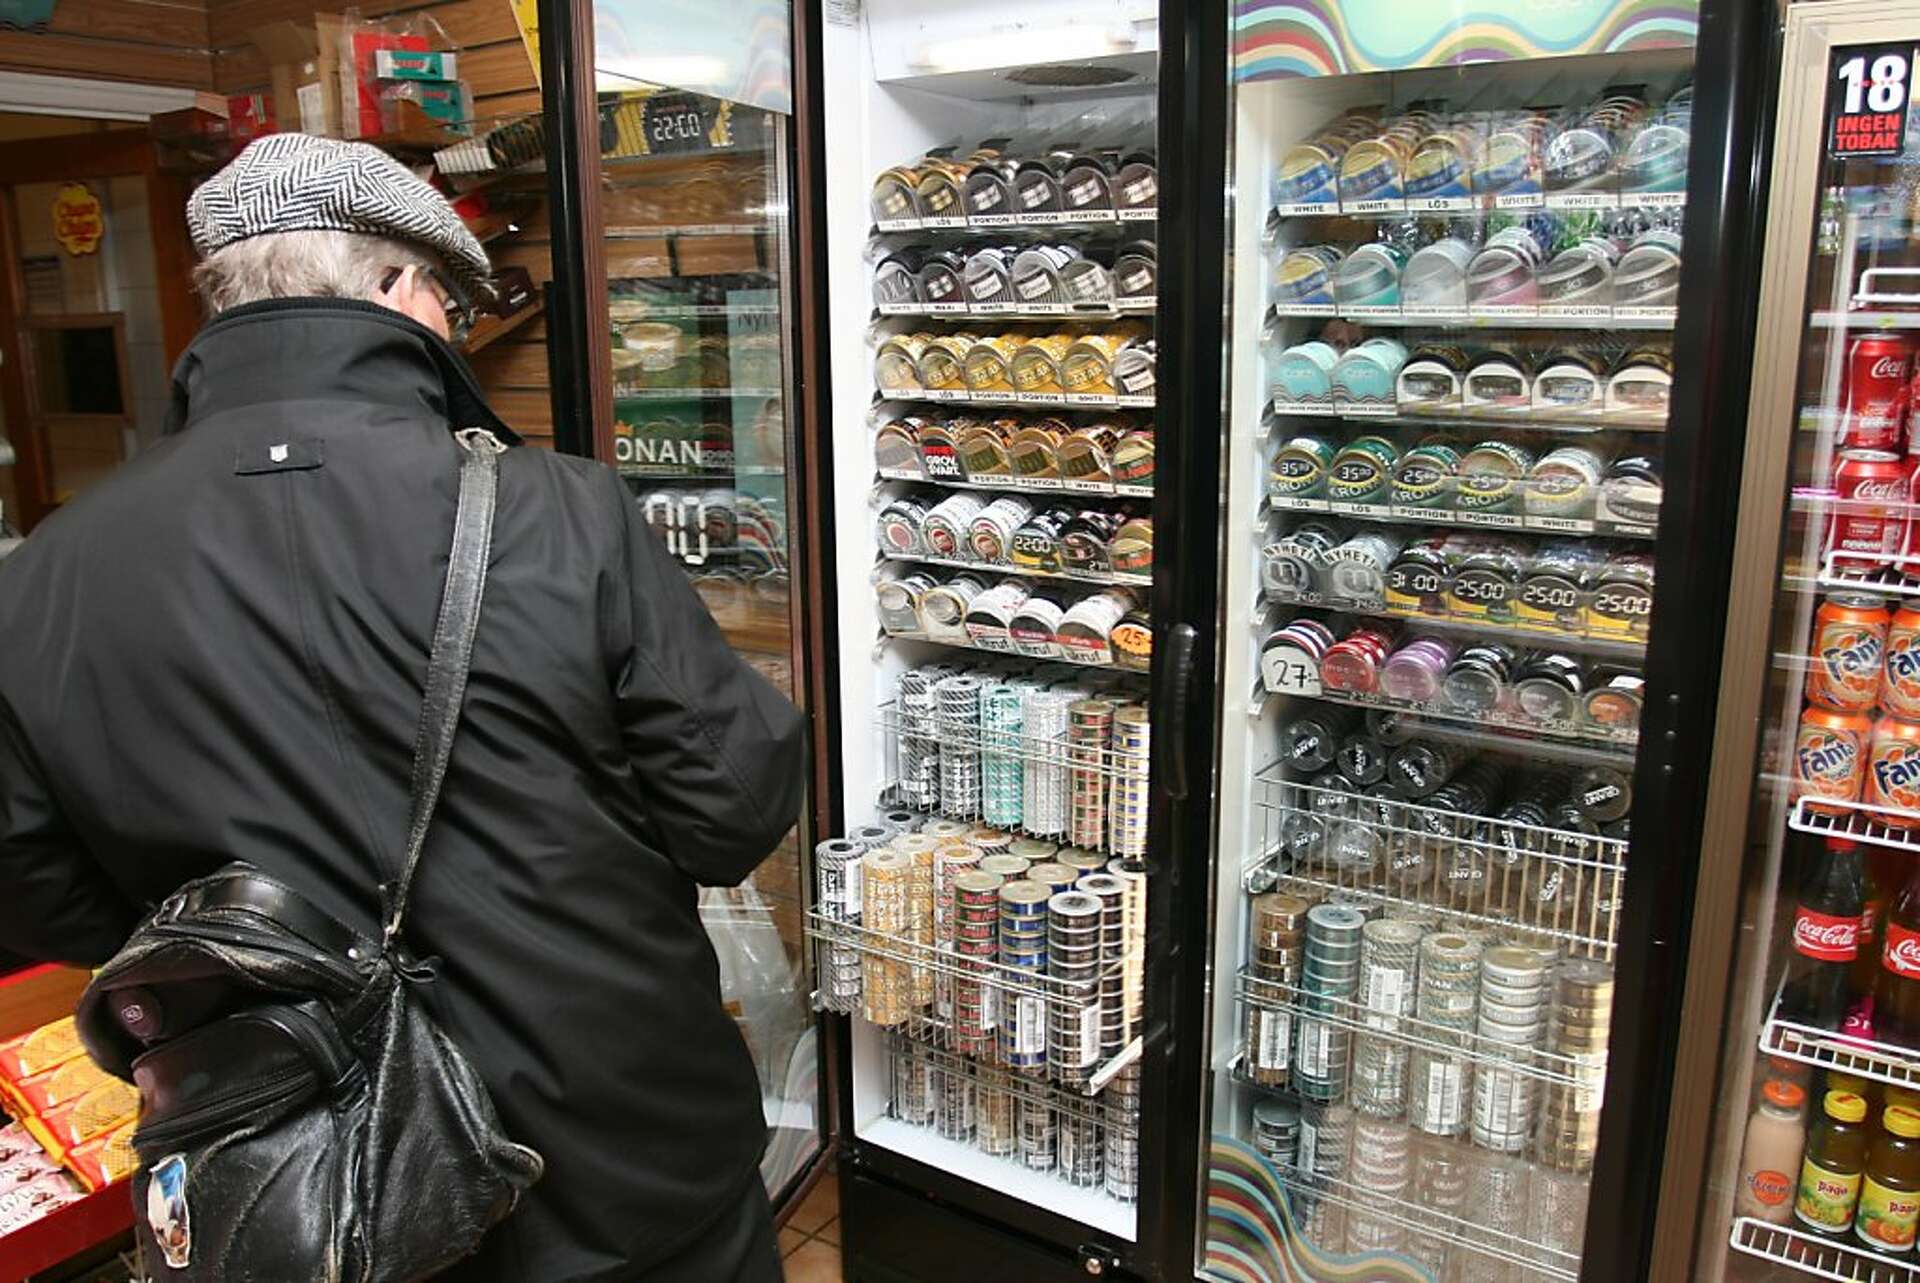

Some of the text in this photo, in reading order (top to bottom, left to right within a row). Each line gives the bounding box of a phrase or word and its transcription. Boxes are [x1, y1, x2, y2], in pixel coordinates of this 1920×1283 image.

[1838, 55, 1907, 113] 18
[1837, 114, 1900, 134] INGEN
[1836, 133, 1899, 151] TOBAK
[1501, 196, 1537, 206] WHITE
[1562, 196, 1600, 206] WHITE
[1638, 194, 1681, 204] WHITE
[1292, 204, 1325, 213] WHITE
[1356, 201, 1390, 211] WHITE
[1070, 212, 1109, 220] PORTION
[1123, 211, 1156, 219] PORTIO
[973, 216, 1010, 225] PORTION
[1399, 508, 1448, 519] PORTION
[1466, 513, 1515, 525] PORTION
[1542, 519, 1577, 529] WHITE
[1264, 547, 1318, 562] NYHET!
[1823, 637, 1882, 683] Fant
[1873, 751, 1920, 796] Fan
